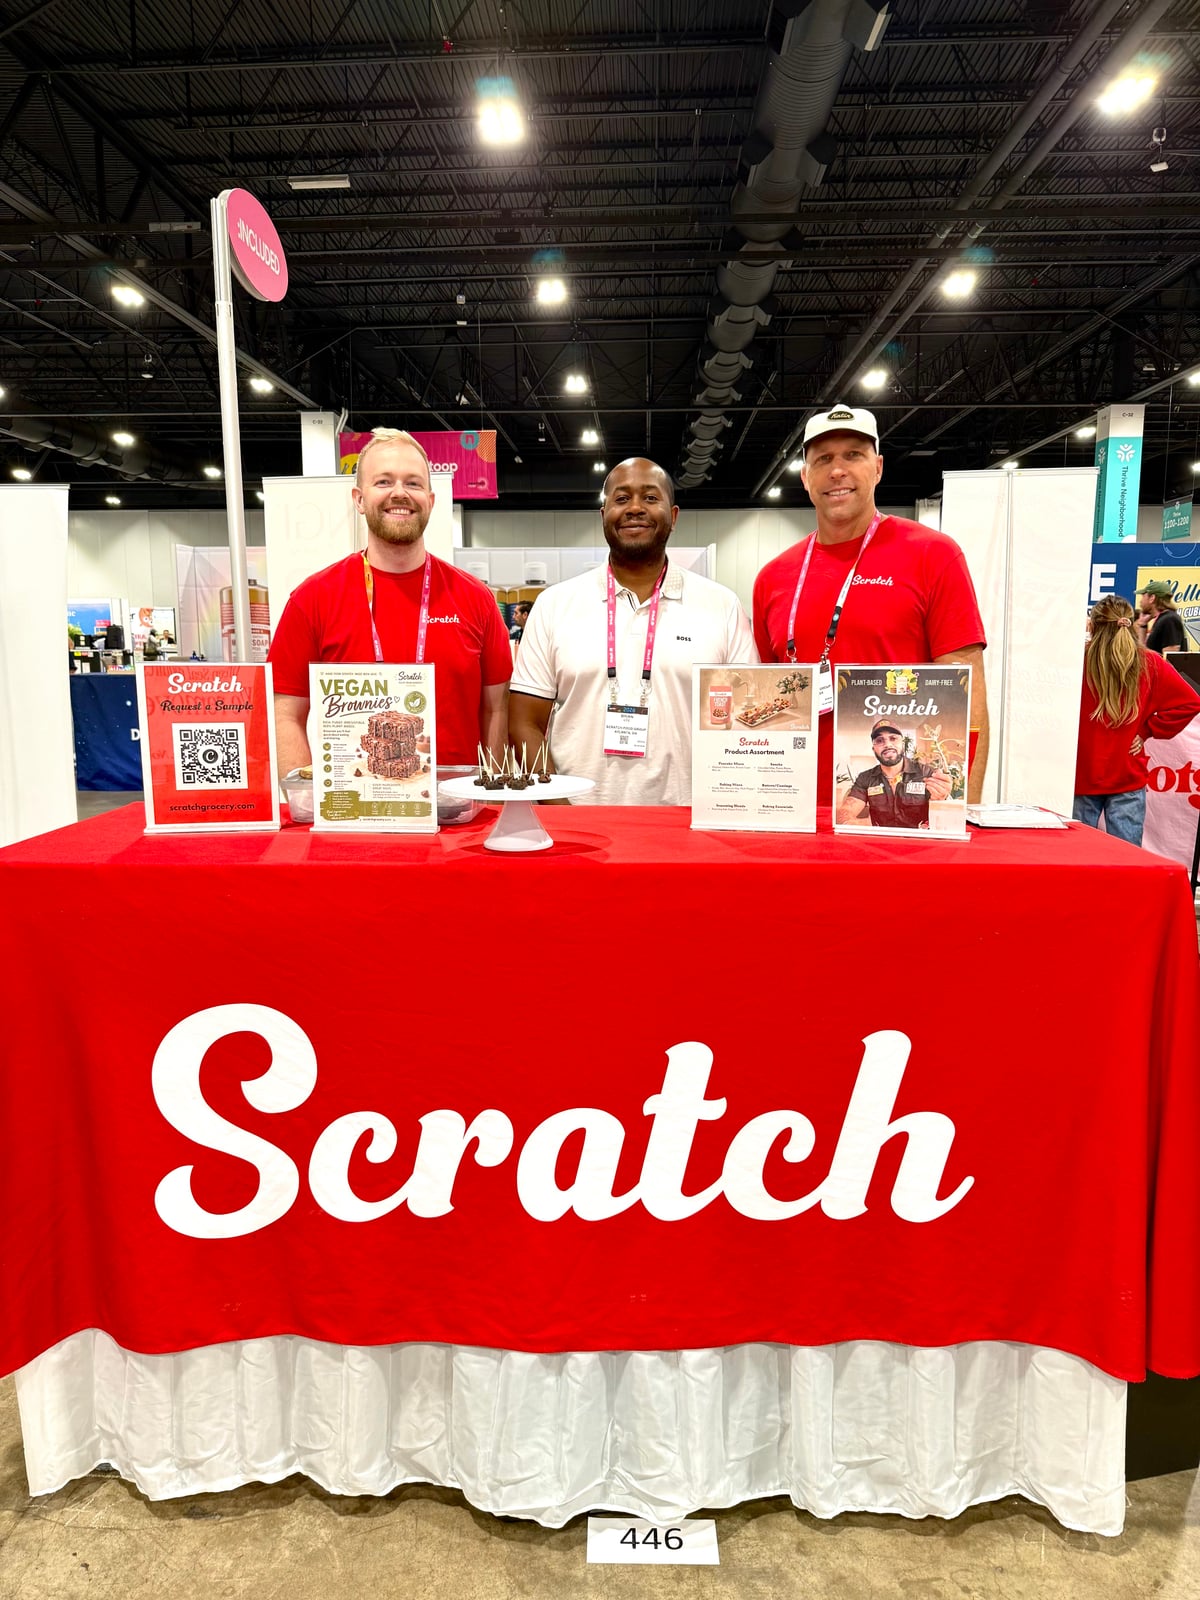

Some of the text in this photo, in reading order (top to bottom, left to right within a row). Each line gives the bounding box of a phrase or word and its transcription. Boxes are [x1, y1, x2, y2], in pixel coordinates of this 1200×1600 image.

[1117, 465, 1129, 538] Thrive Neighborhood
[852, 574, 894, 587] Scratch
[167, 672, 243, 695] Scratch
[398, 671, 422, 681] Scratch
[850, 679, 883, 687] PLANT-BASED
[924, 679, 954, 687] DAIRY-FREE
[319, 679, 389, 697] VEGAN
[160, 699, 202, 712] Request
[215, 700, 254, 712] Sample
[322, 693, 393, 719] Brownies
[863, 695, 940, 717] Scratch
[739, 737, 769, 747] Scratch
[169, 802, 255, 812] scratchgrocery.com
[151, 1002, 975, 1240] Scratch
[619, 1527, 684, 1550] 446
